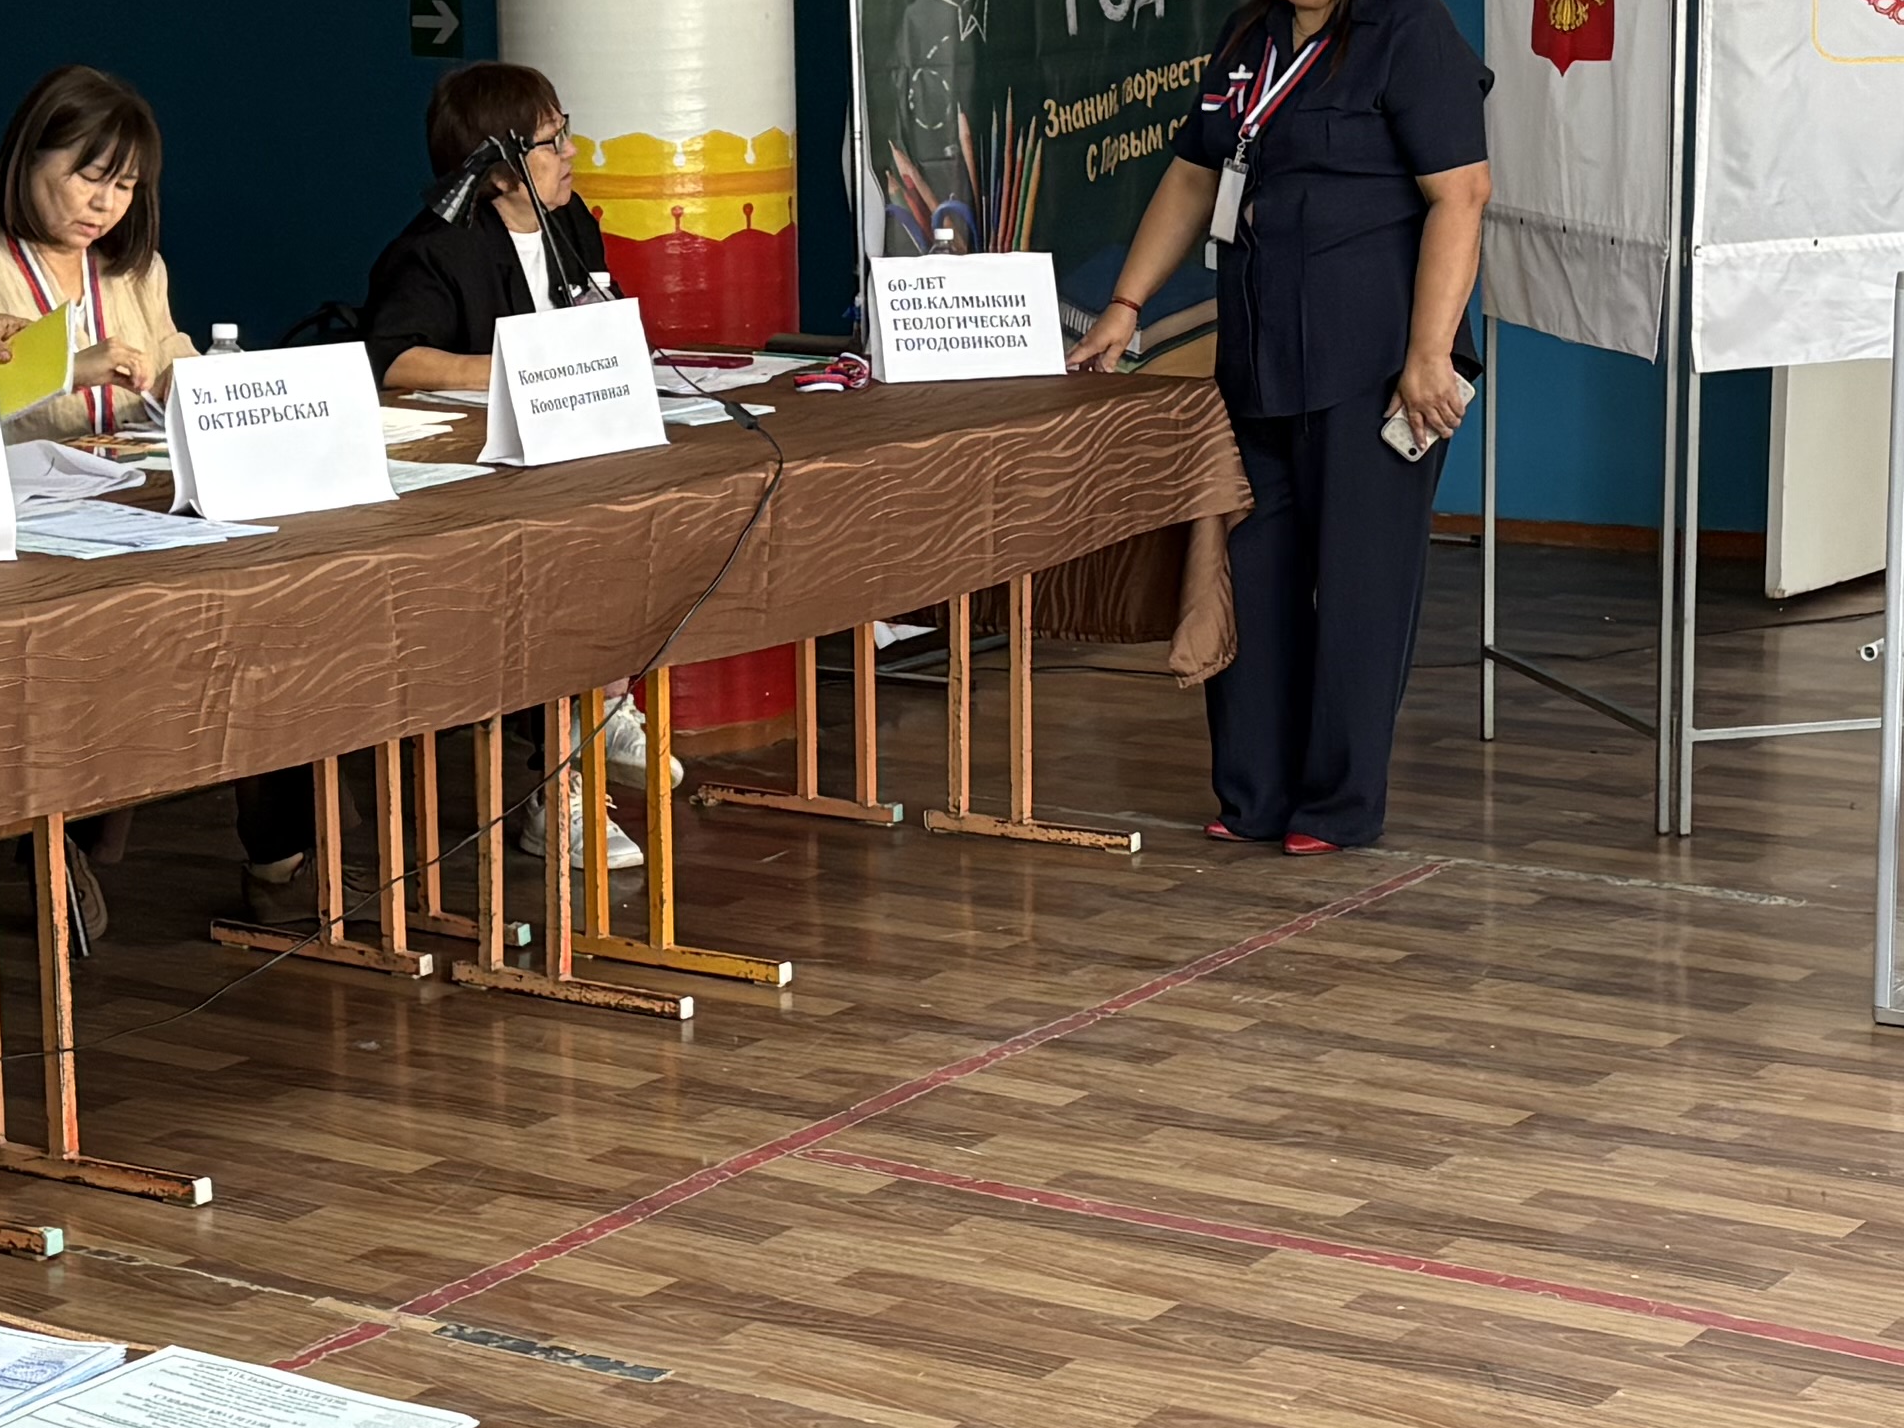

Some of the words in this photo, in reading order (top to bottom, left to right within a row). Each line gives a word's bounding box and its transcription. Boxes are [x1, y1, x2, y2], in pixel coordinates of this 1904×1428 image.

[888, 276, 946, 292] 60-ЛЕТ
[890, 294, 1027, 312] СОВ.КАЛМЫКИИ
[893, 314, 1032, 332] ГЕОЛОГИЧЕСКАЯ
[895, 334, 1029, 353] ГОРОДОВИКОВА
[518, 353, 620, 387] Комсомольская
[192, 384, 217, 406] Ул.
[226, 378, 288, 402] НОВАЯ
[529, 381, 632, 417] Кооперативная
[198, 400, 330, 432] ОКТЯБРЬСКАЯ
